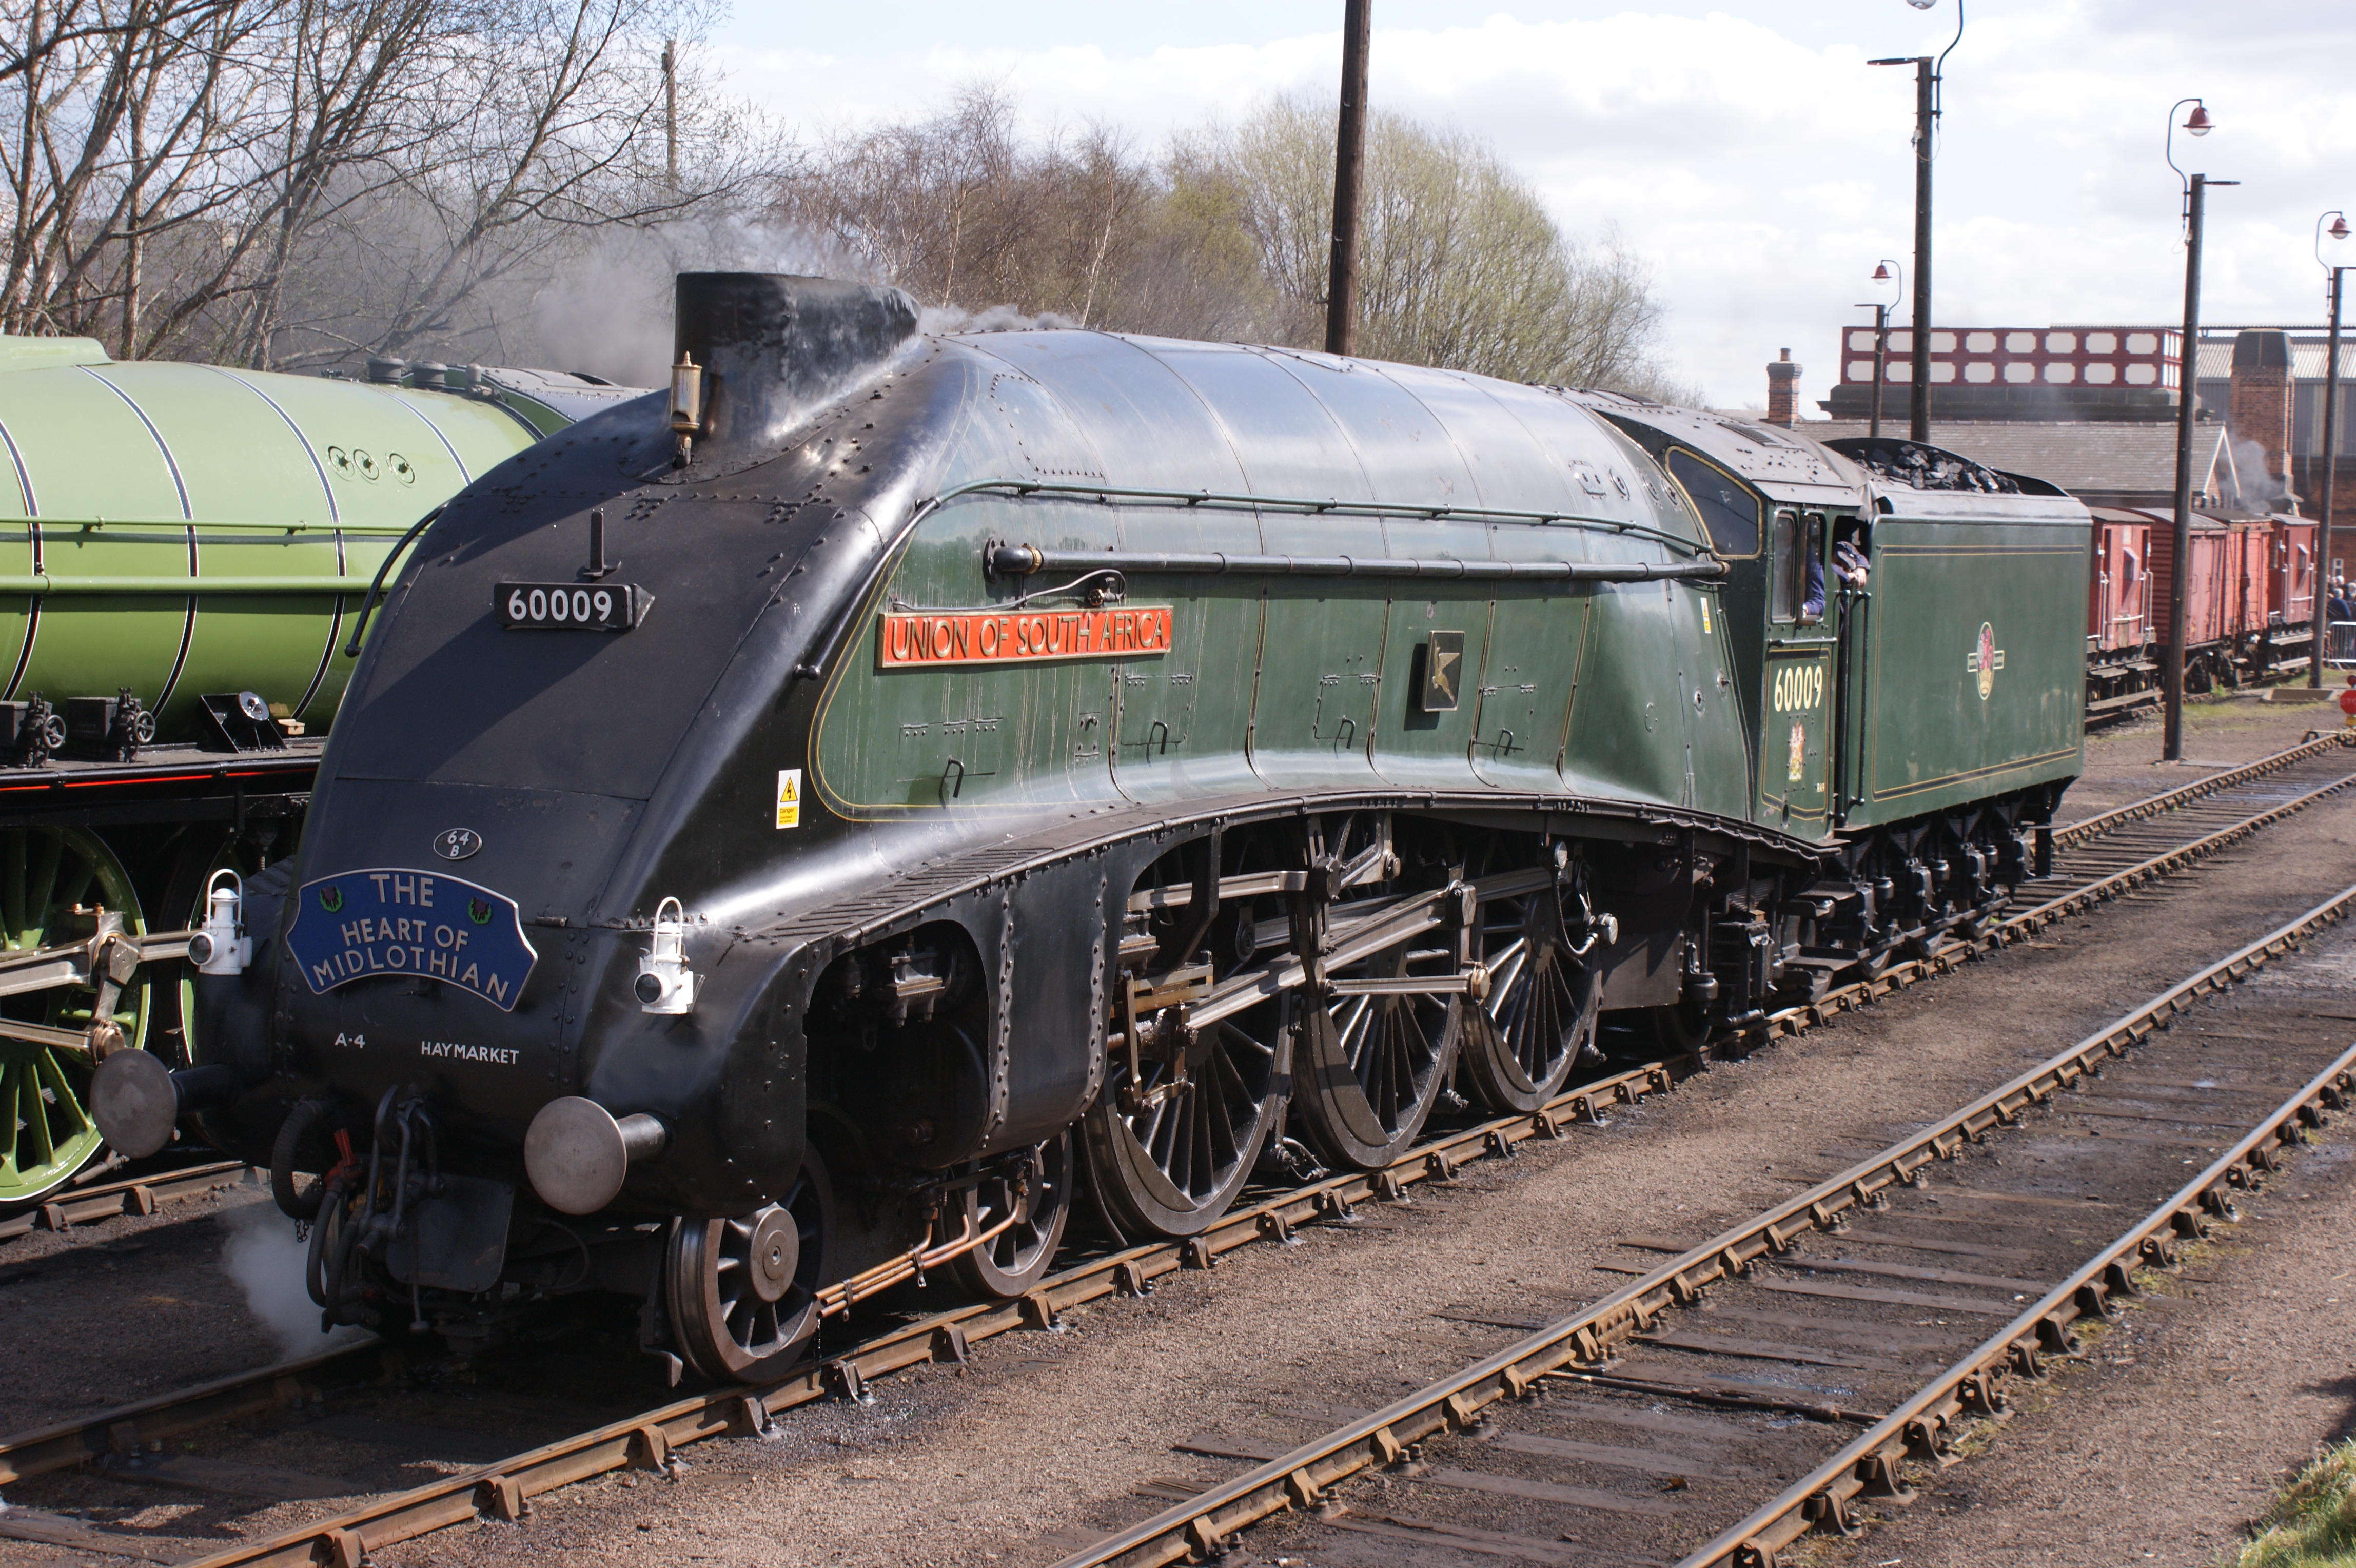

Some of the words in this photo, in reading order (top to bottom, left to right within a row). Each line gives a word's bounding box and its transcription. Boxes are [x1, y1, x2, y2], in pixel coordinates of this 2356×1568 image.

[509, 589, 612, 622] 60009
[892, 619, 970, 660] UNION
[980, 618, 1009, 657] OF
[1017, 615, 1092, 655] SOUTH
[1099, 612, 1164, 651] AFRICA
[1774, 665, 1823, 712] 60009
[448, 831, 469, 846] 64
[450, 845, 460, 857] B
[370, 874, 434, 907] THE
[341, 918, 427, 946] HEART
[435, 925, 468, 951] OF
[313, 945, 509, 1001] MIDLOTHIAN
[421, 1041, 519, 1064] HAYMARKET
